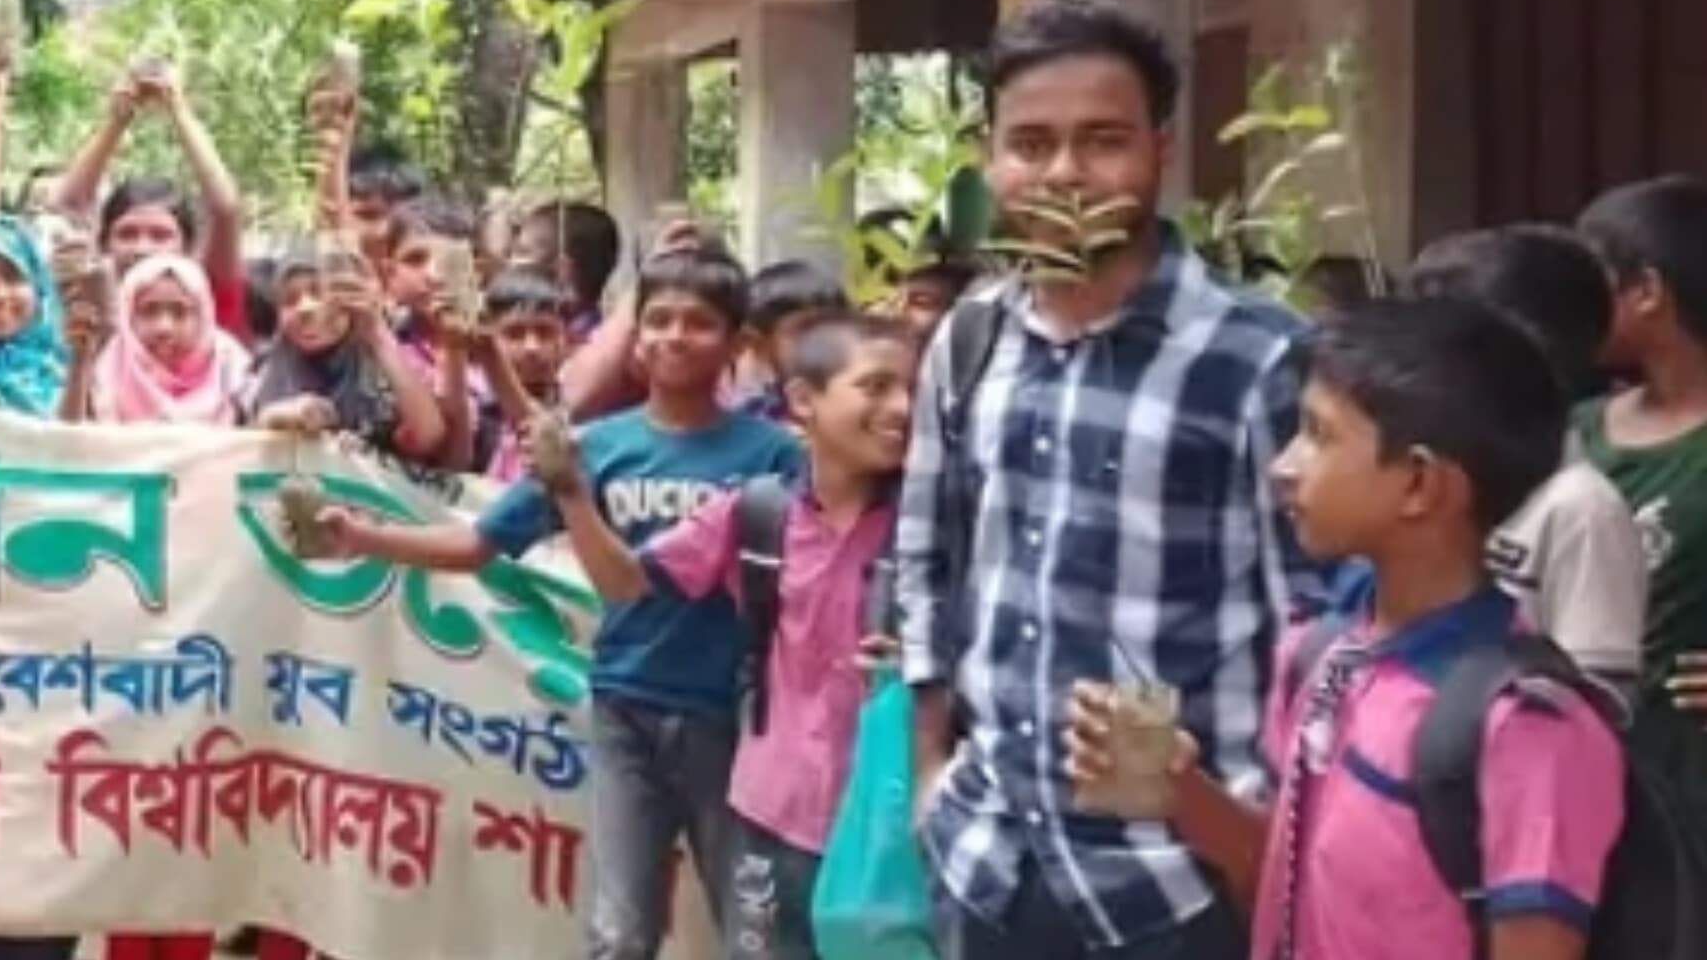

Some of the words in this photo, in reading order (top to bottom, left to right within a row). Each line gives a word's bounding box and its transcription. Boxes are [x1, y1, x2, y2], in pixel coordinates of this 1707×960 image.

[266, 651, 355, 727] যুব
[386, 678, 589, 792] সংগঠ
[46, 726, 443, 889] বিশ্ববিদ্যালয়
[473, 798, 586, 910] শা
